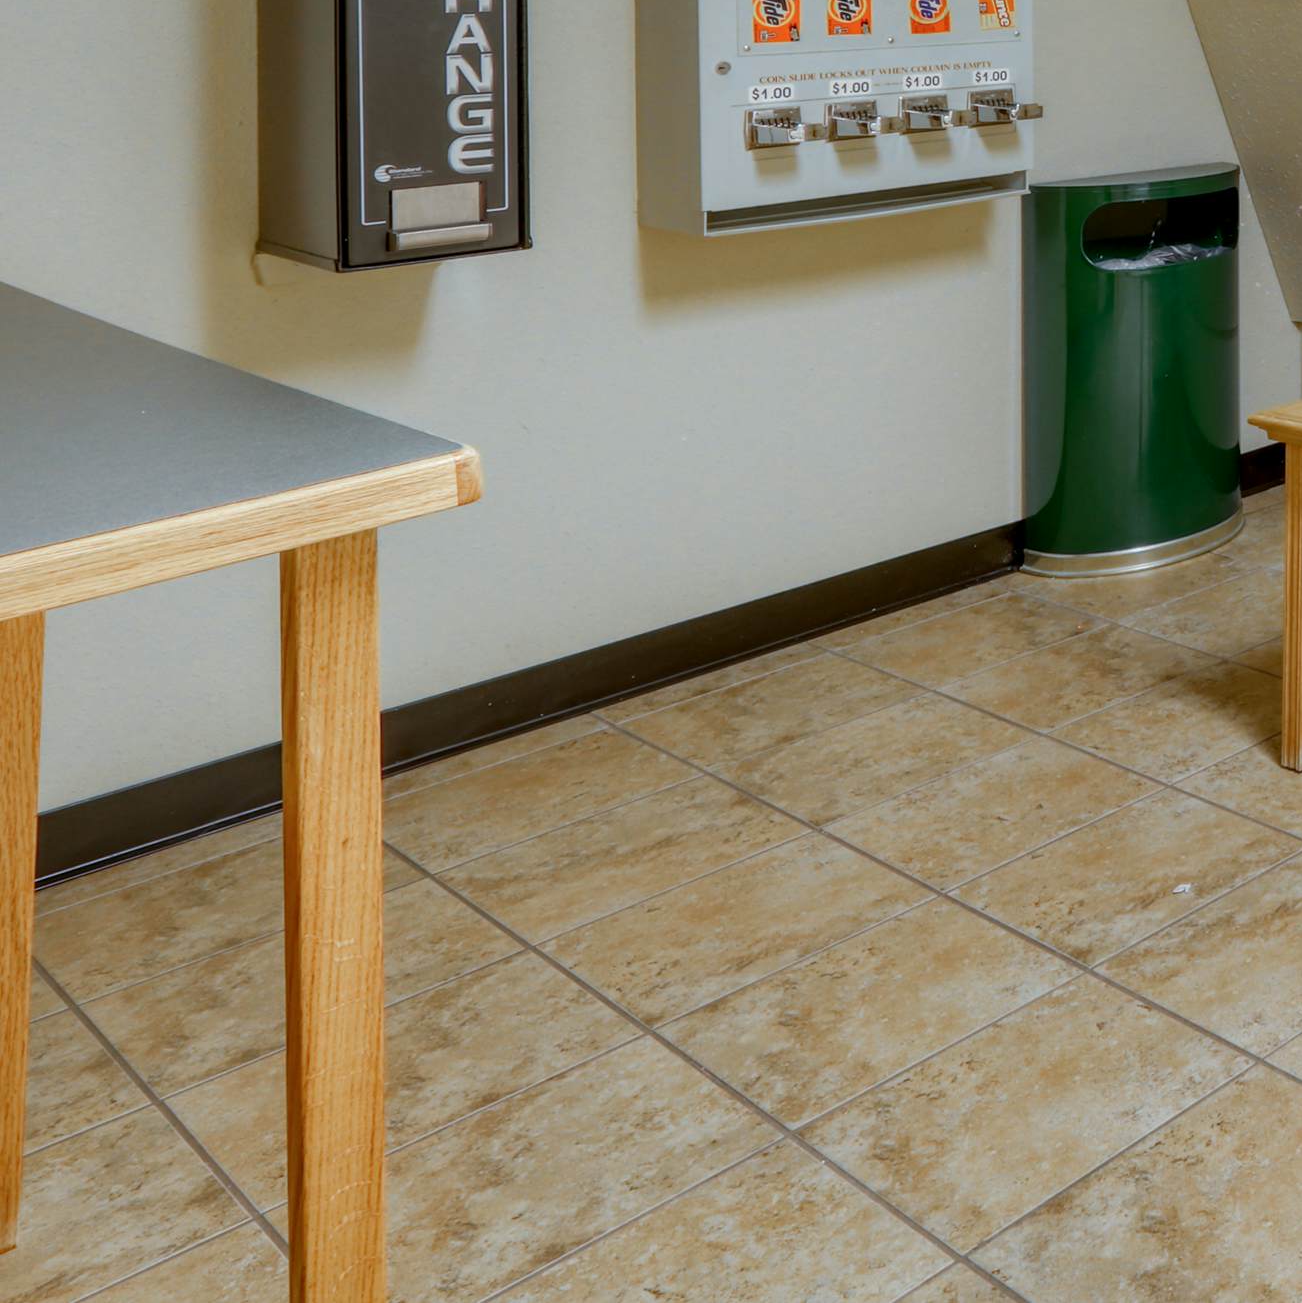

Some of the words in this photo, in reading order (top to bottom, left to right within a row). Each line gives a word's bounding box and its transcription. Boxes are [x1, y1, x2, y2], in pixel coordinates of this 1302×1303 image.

[760, 76, 786, 85] COIN
[788, 74, 816, 82] SLIDE
[879, 67, 908, 75] WHEN
[911, 64, 951, 73] COLUMN
[964, 60, 992, 70] EMPTY
[975, 71, 1008, 82] $1.00
[832, 82, 870, 94] $1.00
[905, 76, 940, 88] $1.00
[752, 87, 792, 100] $1.00
